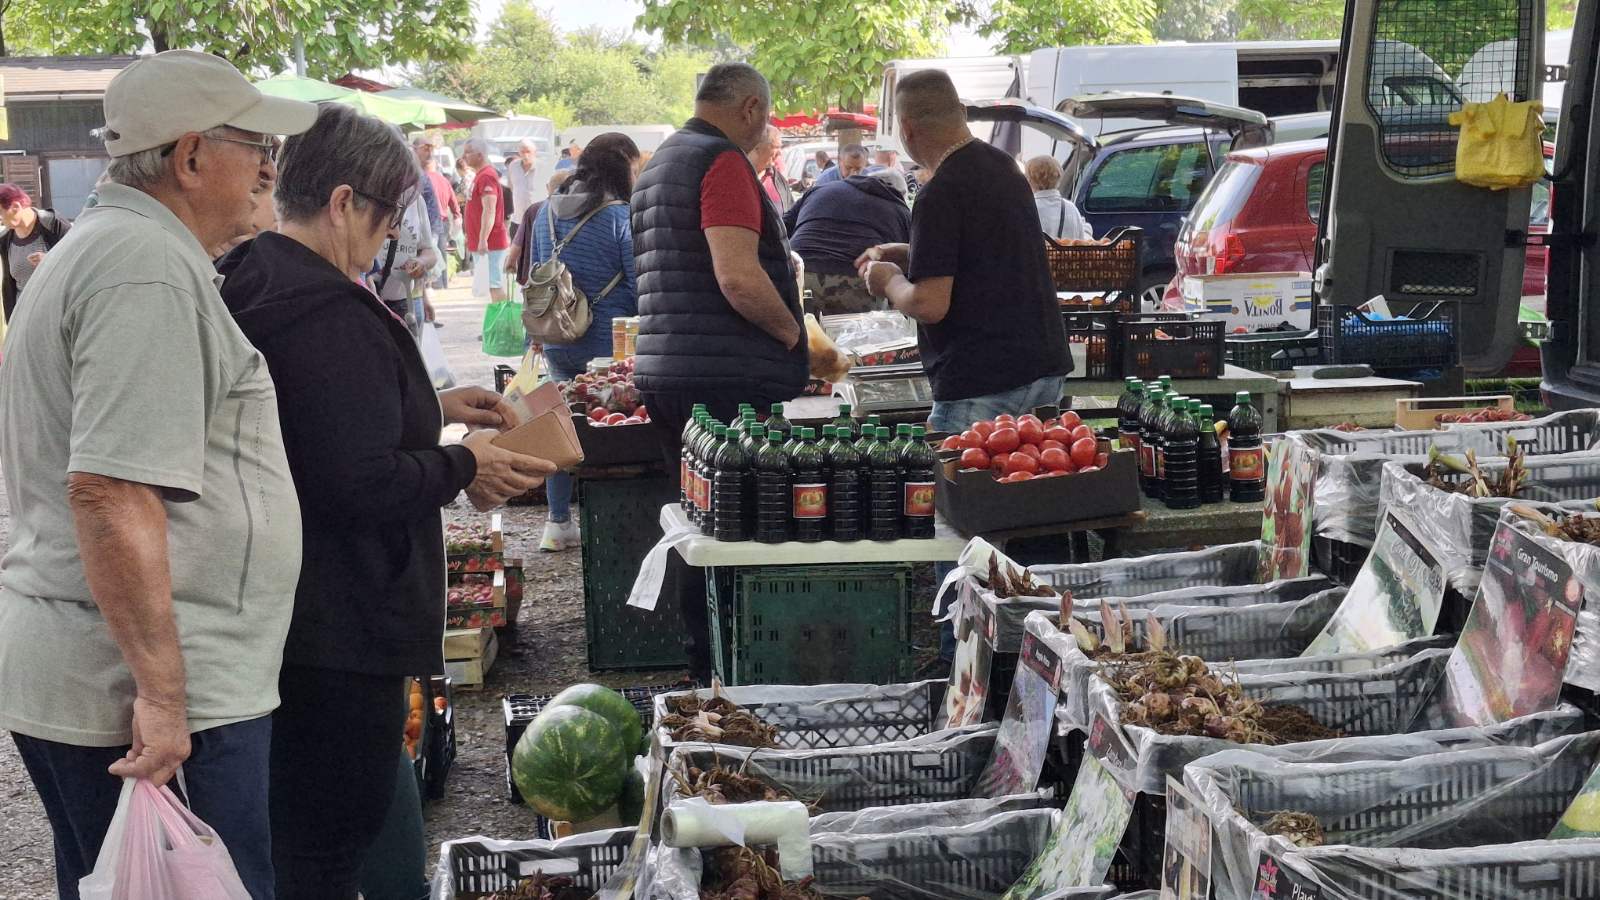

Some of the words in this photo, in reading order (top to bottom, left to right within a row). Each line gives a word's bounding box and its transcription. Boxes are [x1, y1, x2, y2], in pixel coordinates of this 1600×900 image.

[1243, 298, 1283, 317] BONITA
[1517, 547, 1532, 567] Gran
[1531, 555, 1559, 583] Tourismo
